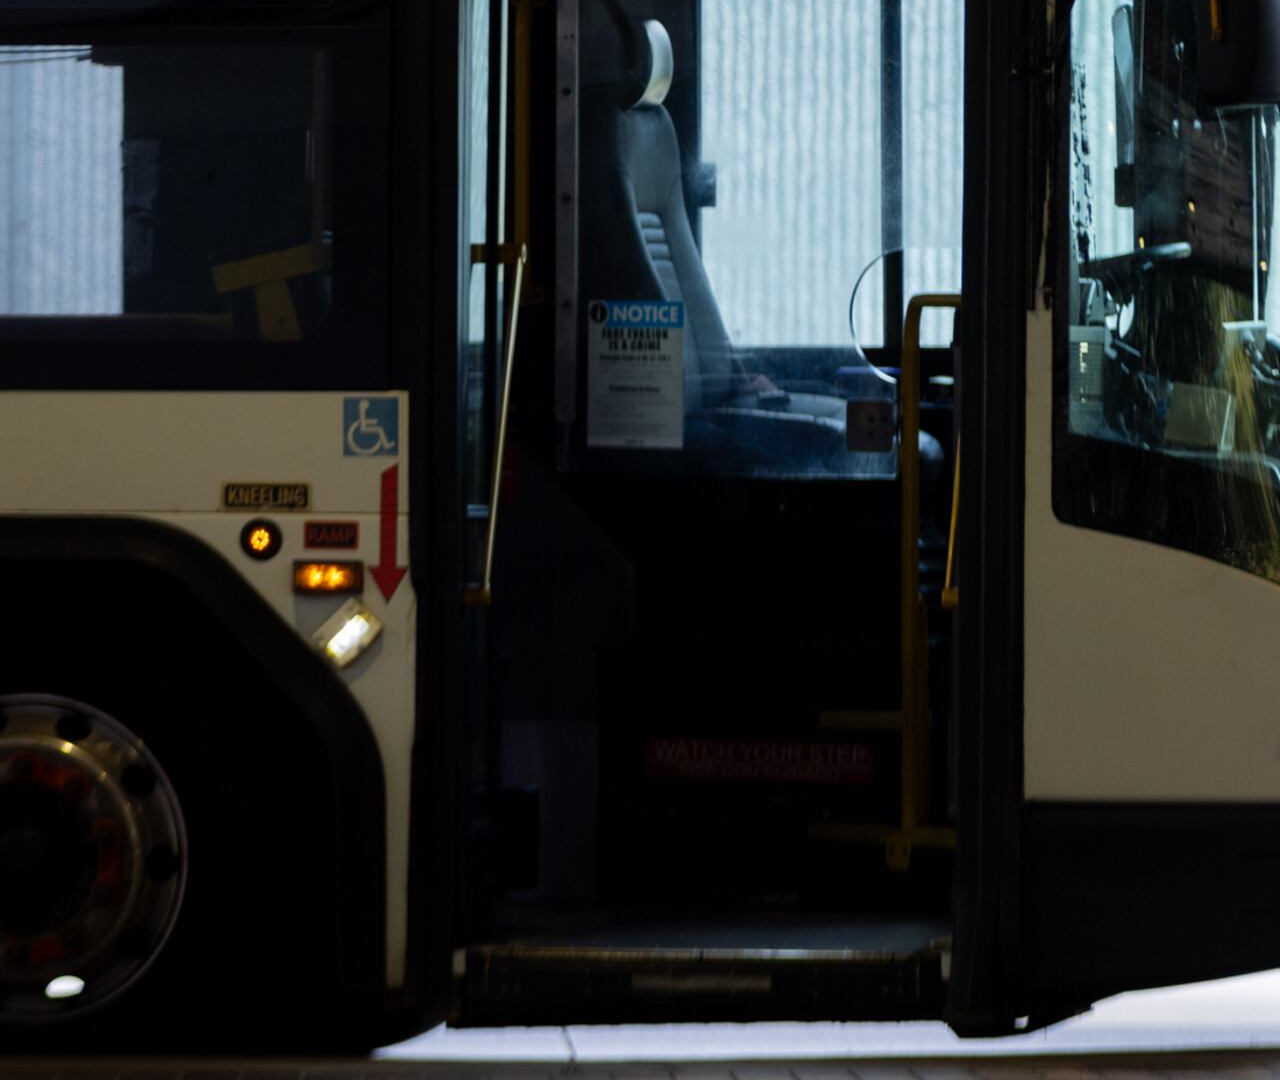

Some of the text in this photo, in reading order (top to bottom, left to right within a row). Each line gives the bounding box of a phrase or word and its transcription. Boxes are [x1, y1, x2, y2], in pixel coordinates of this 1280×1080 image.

[613, 305, 679, 323] NOTICE
[227, 484, 306, 506] KNEELING
[308, 526, 355, 546] RAMP
[655, 738, 868, 767] WATCH YOUR STEP
